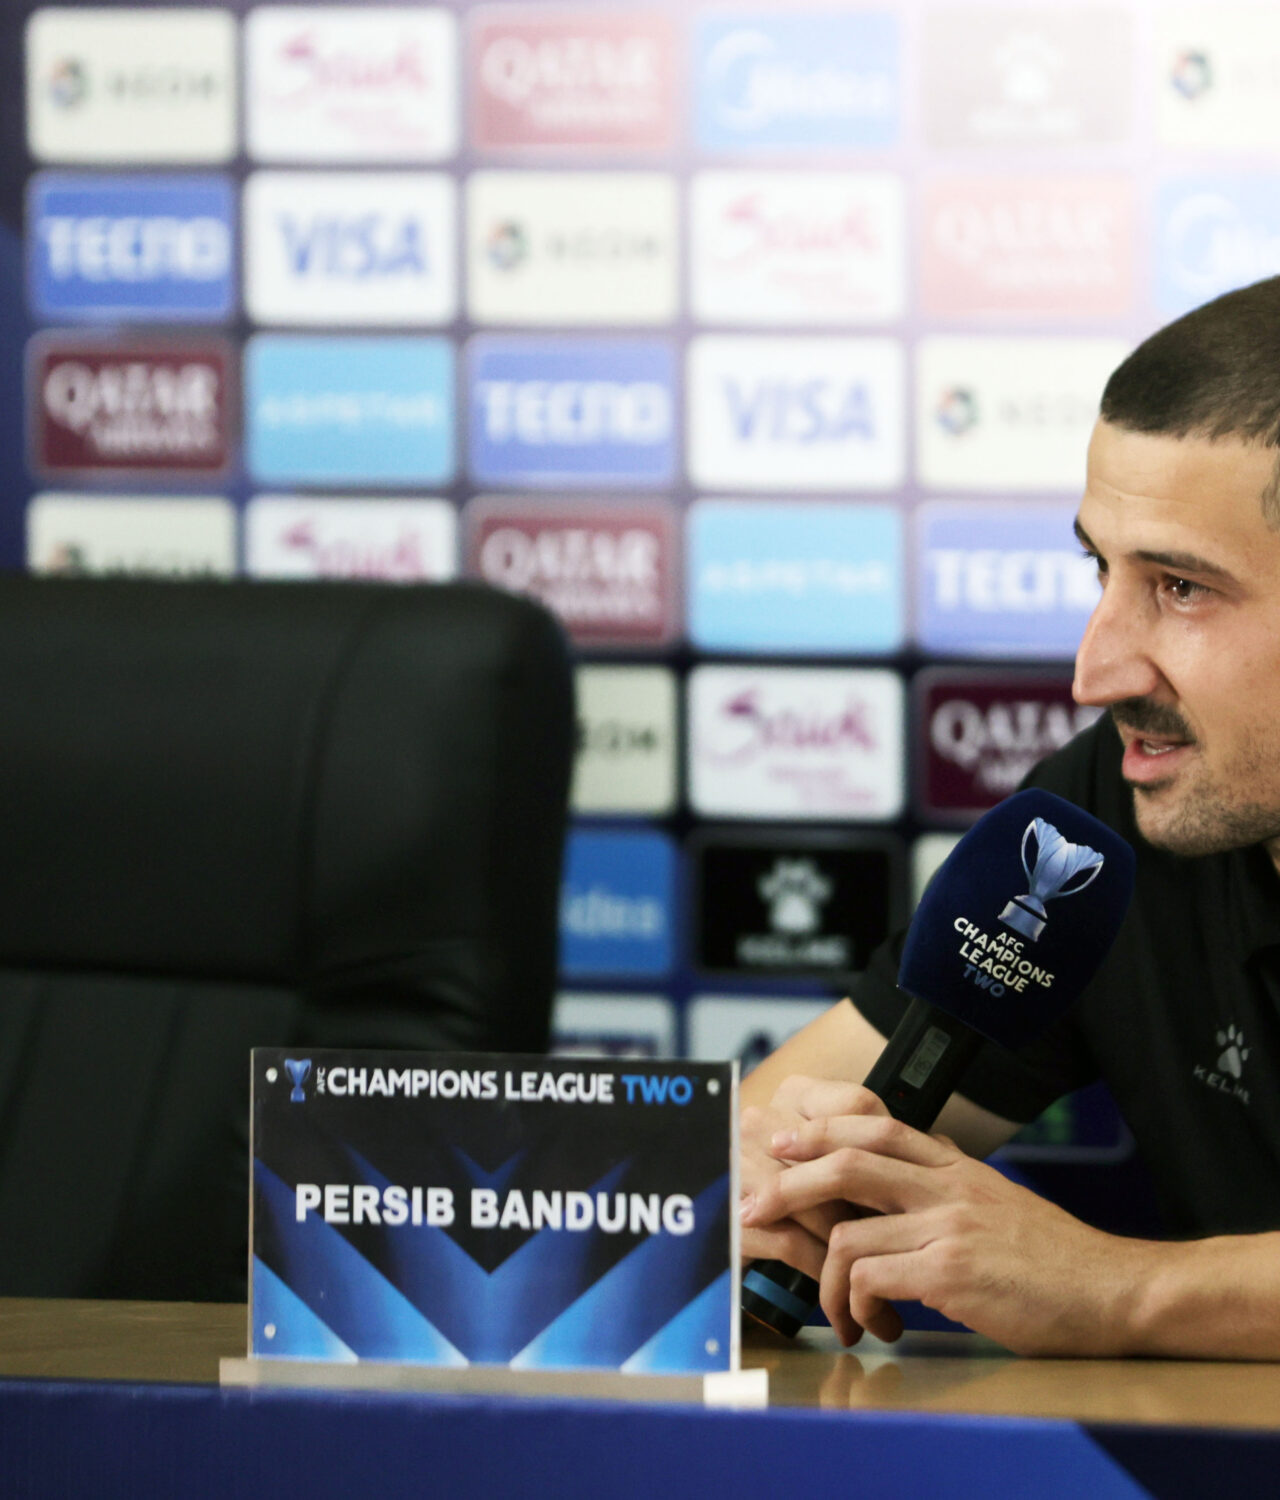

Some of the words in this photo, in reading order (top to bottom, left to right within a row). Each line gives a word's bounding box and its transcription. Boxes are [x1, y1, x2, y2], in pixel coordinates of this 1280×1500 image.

[43, 216, 230, 281] TECNO
[280, 211, 427, 276] VISA
[483, 381, 675, 445] TECNO
[721, 376, 876, 442] VISA
[953, 917, 1055, 988] CHAMPIONS
[959, 941, 1029, 993] LEAGUE
[996, 932, 1025, 953] AFC
[963, 963, 1005, 998] TWO
[327, 1067, 499, 1099] CHAMPIONS
[504, 1071, 615, 1104] LEAGUE
[621, 1074, 694, 1106] TWO
[296, 1183, 456, 1228] PERSIB
[471, 1187, 695, 1236] BANDUNG
